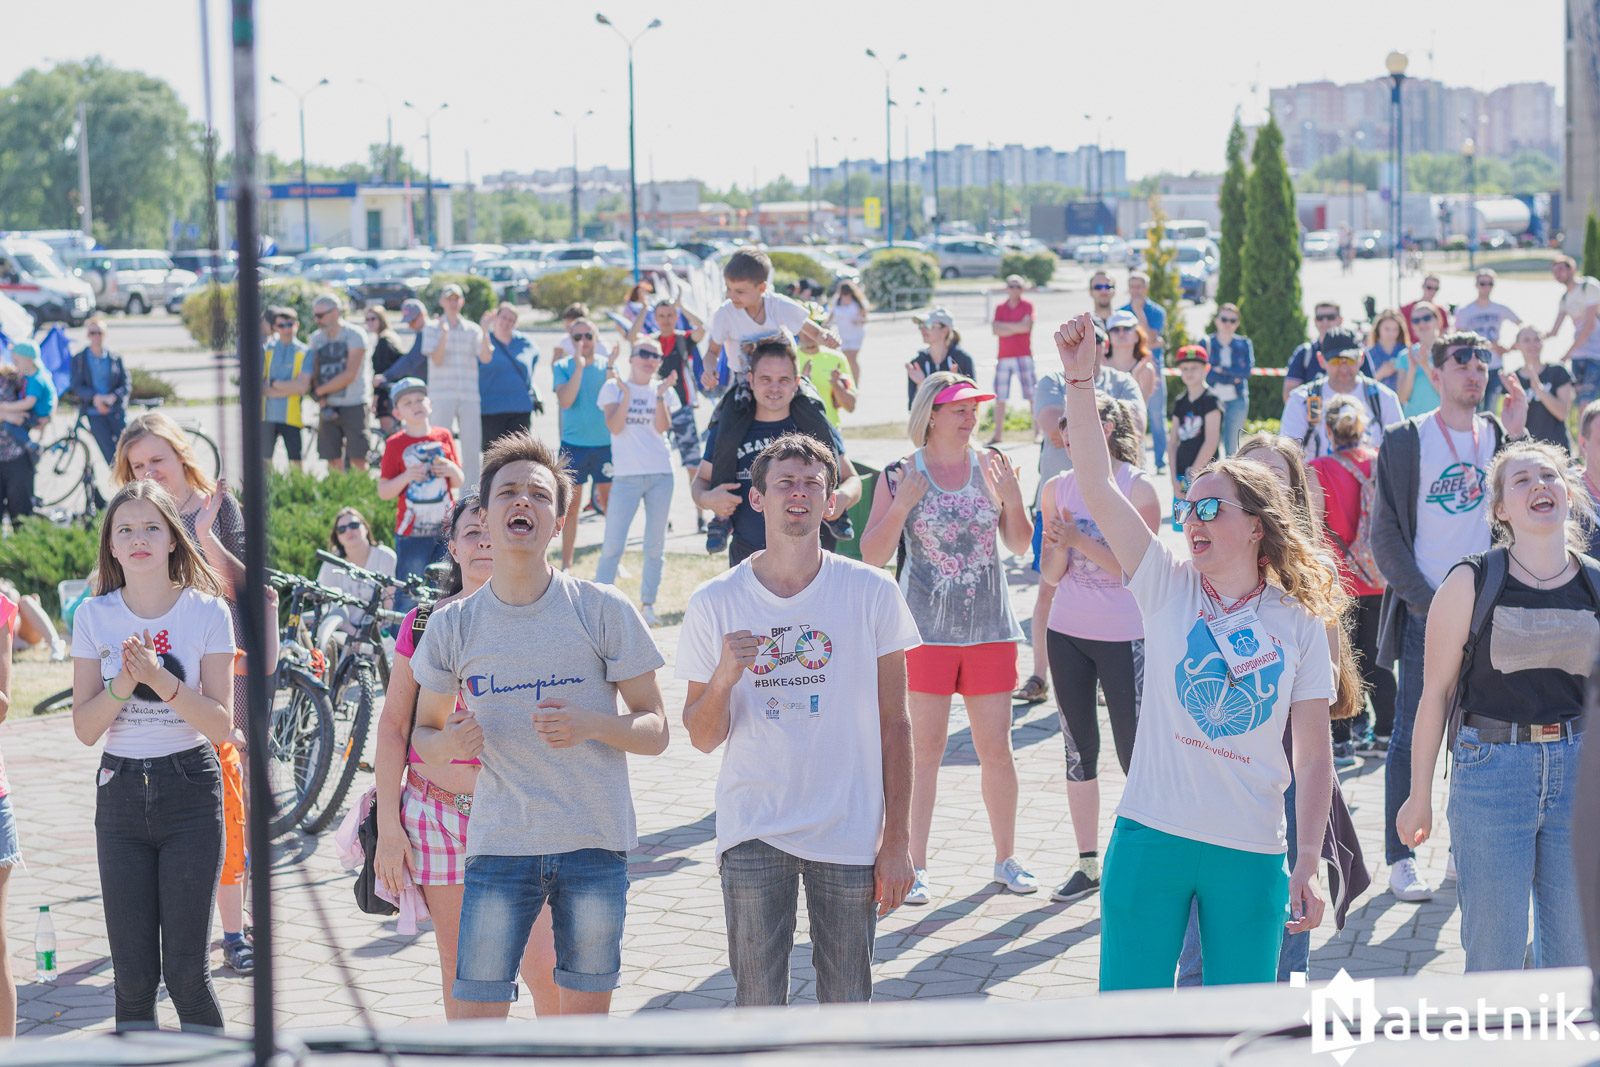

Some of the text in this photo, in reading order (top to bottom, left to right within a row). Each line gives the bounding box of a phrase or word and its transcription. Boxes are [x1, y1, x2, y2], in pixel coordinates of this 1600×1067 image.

[626, 417, 650, 425] CRAZY
[771, 626, 793, 638] BIKE
[1233, 651, 1278, 675] КООРДИНАТОР
[467, 674, 586, 701] Champion
[754, 674, 826, 688] #BIKE4SDGS
